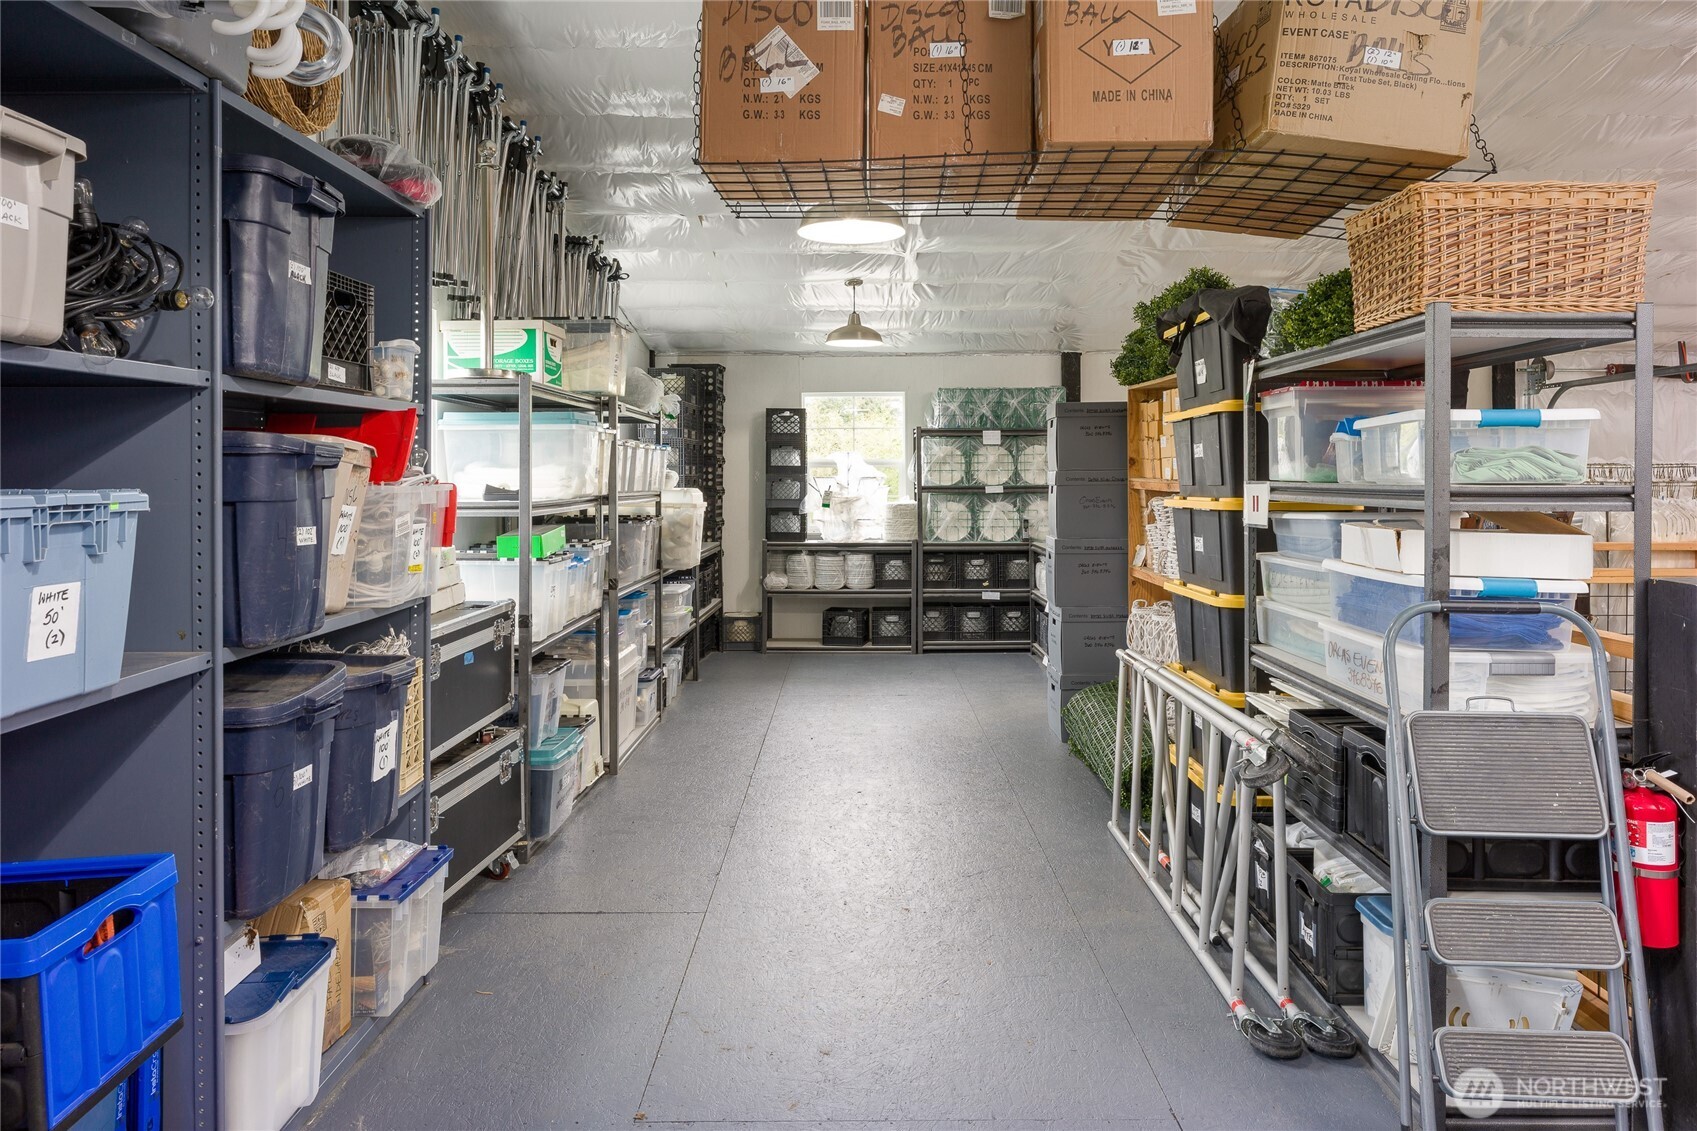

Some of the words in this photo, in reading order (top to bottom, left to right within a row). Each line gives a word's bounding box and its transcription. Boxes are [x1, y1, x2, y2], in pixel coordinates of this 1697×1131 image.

[722, 0, 813, 27] DISCO
[1064, 2, 1126, 27] BALL
[1285, 10, 1377, 25] WHOLESALE
[1282, 27, 1319, 38] EVENT
[1280, 52, 1306, 60] ITEM#
[1309, 54, 1337, 63] 867075
[978, 63, 992, 73] CM
[1280, 60, 1339, 71] DESCRIPTION:
[1339, 66, 1361, 75] Koyal
[1362, 68, 1400, 80] Wholesale
[913, 79, 936, 89] QTY:
[969, 77, 980, 87] PC
[1278, 77, 1310, 86] COLOR:
[1310, 79, 1332, 88] Matte
[1333, 82, 1355, 91] Black
[1337, 74, 1356, 83] (Test
[1357, 76, 1377, 84] Tube
[1378, 78, 1392, 87] Set,
[1393, 80, 1418, 91] Black)
[743, 94, 768, 104] N.W.:
[800, 94, 821, 104] KGS
[913, 95, 938, 104] N.W.:
[969, 94, 990, 104] KGS
[1092, 89, 1121, 102] MADE
[1126, 89, 1136, 102] IN
[1141, 88, 1173, 101] CHINA
[1275, 93, 1295, 102] QTY:
[1276, 85, 1293, 93] NET
[1295, 86, 1310, 94] WT:
[1311, 88, 1332, 96] 10.03
[1335, 91, 1351, 99] LBS
[1274, 101, 1291, 109] PO#
[1292, 102, 1311, 111] 5329
[743, 110, 768, 120] G.W.:
[800, 110, 821, 119] KGS
[913, 110, 938, 120] G.W.:
[969, 110, 990, 120] KGS
[1273, 110, 1297, 118] MADE
[1299, 111, 1308, 119] IN
[1308, 112, 1334, 122] CHINA
[38, 588, 69, 605] WHITE
[43, 606, 64, 626] 50'
[45, 628, 65, 649] (2)
[1328, 641, 1351, 665] ORCAS
